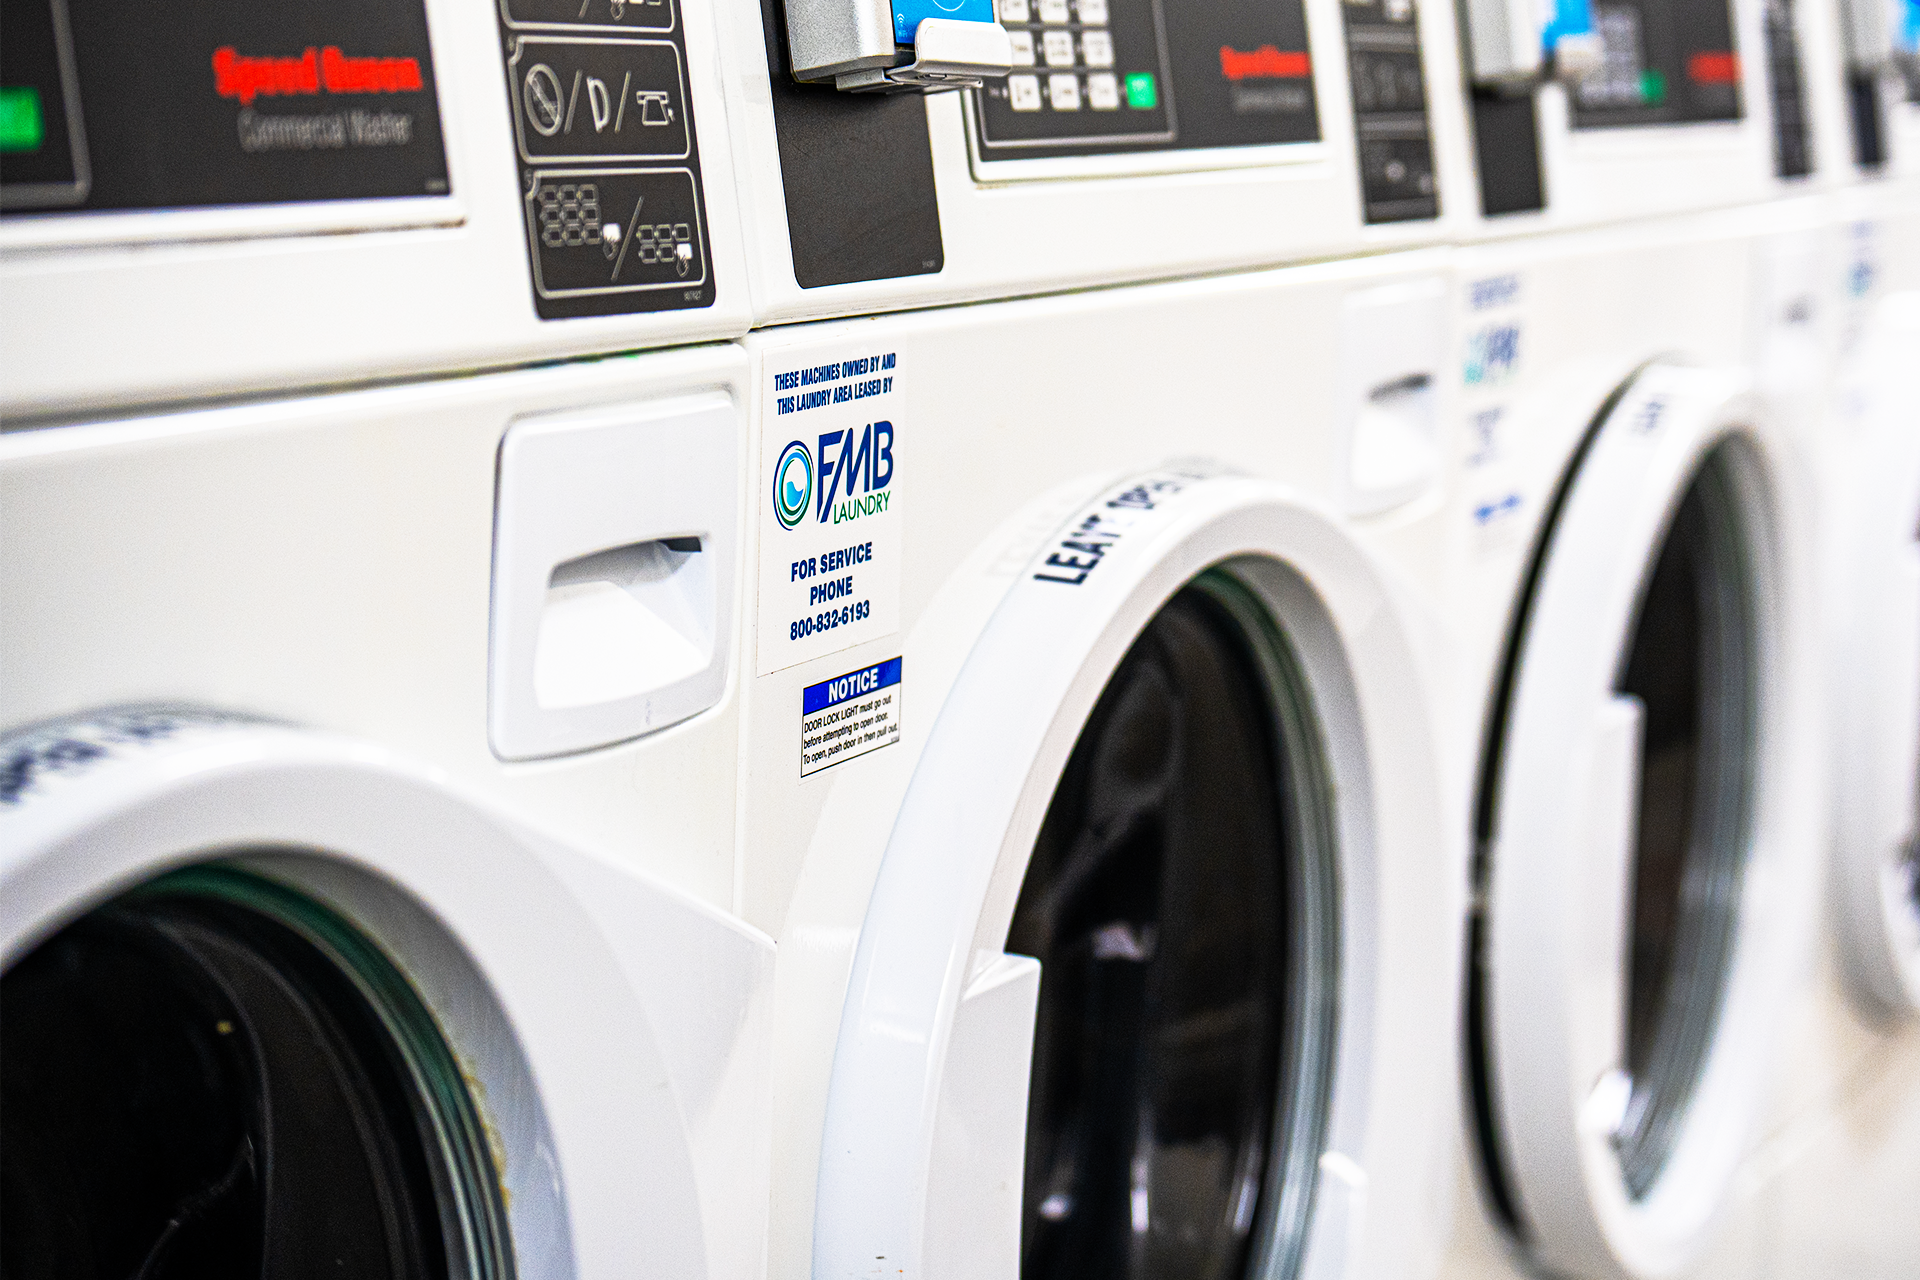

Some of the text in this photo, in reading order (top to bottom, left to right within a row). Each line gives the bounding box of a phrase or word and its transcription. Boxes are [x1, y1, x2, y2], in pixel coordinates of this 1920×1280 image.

[775, 352, 896, 391] THESE MACHINES OWNED BY AND
[777, 376, 893, 415] THIS LAUNDRY AREA LEASED BY
[817, 420, 894, 523] FMB
[833, 491, 891, 524] LAUNDRY
[791, 541, 872, 582] FOR SERVICE
[810, 576, 853, 606] PHONE
[790, 600, 870, 641] 800-832-6193
[828, 668, 878, 703] NOTICE
[804, 694, 892, 733] DOOR LOCK LIGHT must go out
[804, 711, 888, 749] before attempting to open door.
[803, 754, 810, 764] To
[812, 749, 827, 763] open,
[828, 741, 842, 758] push
[843, 738, 856, 750] door
[857, 735, 863, 744] in
[863, 730, 876, 742] then
[877, 725, 887, 738] pull
